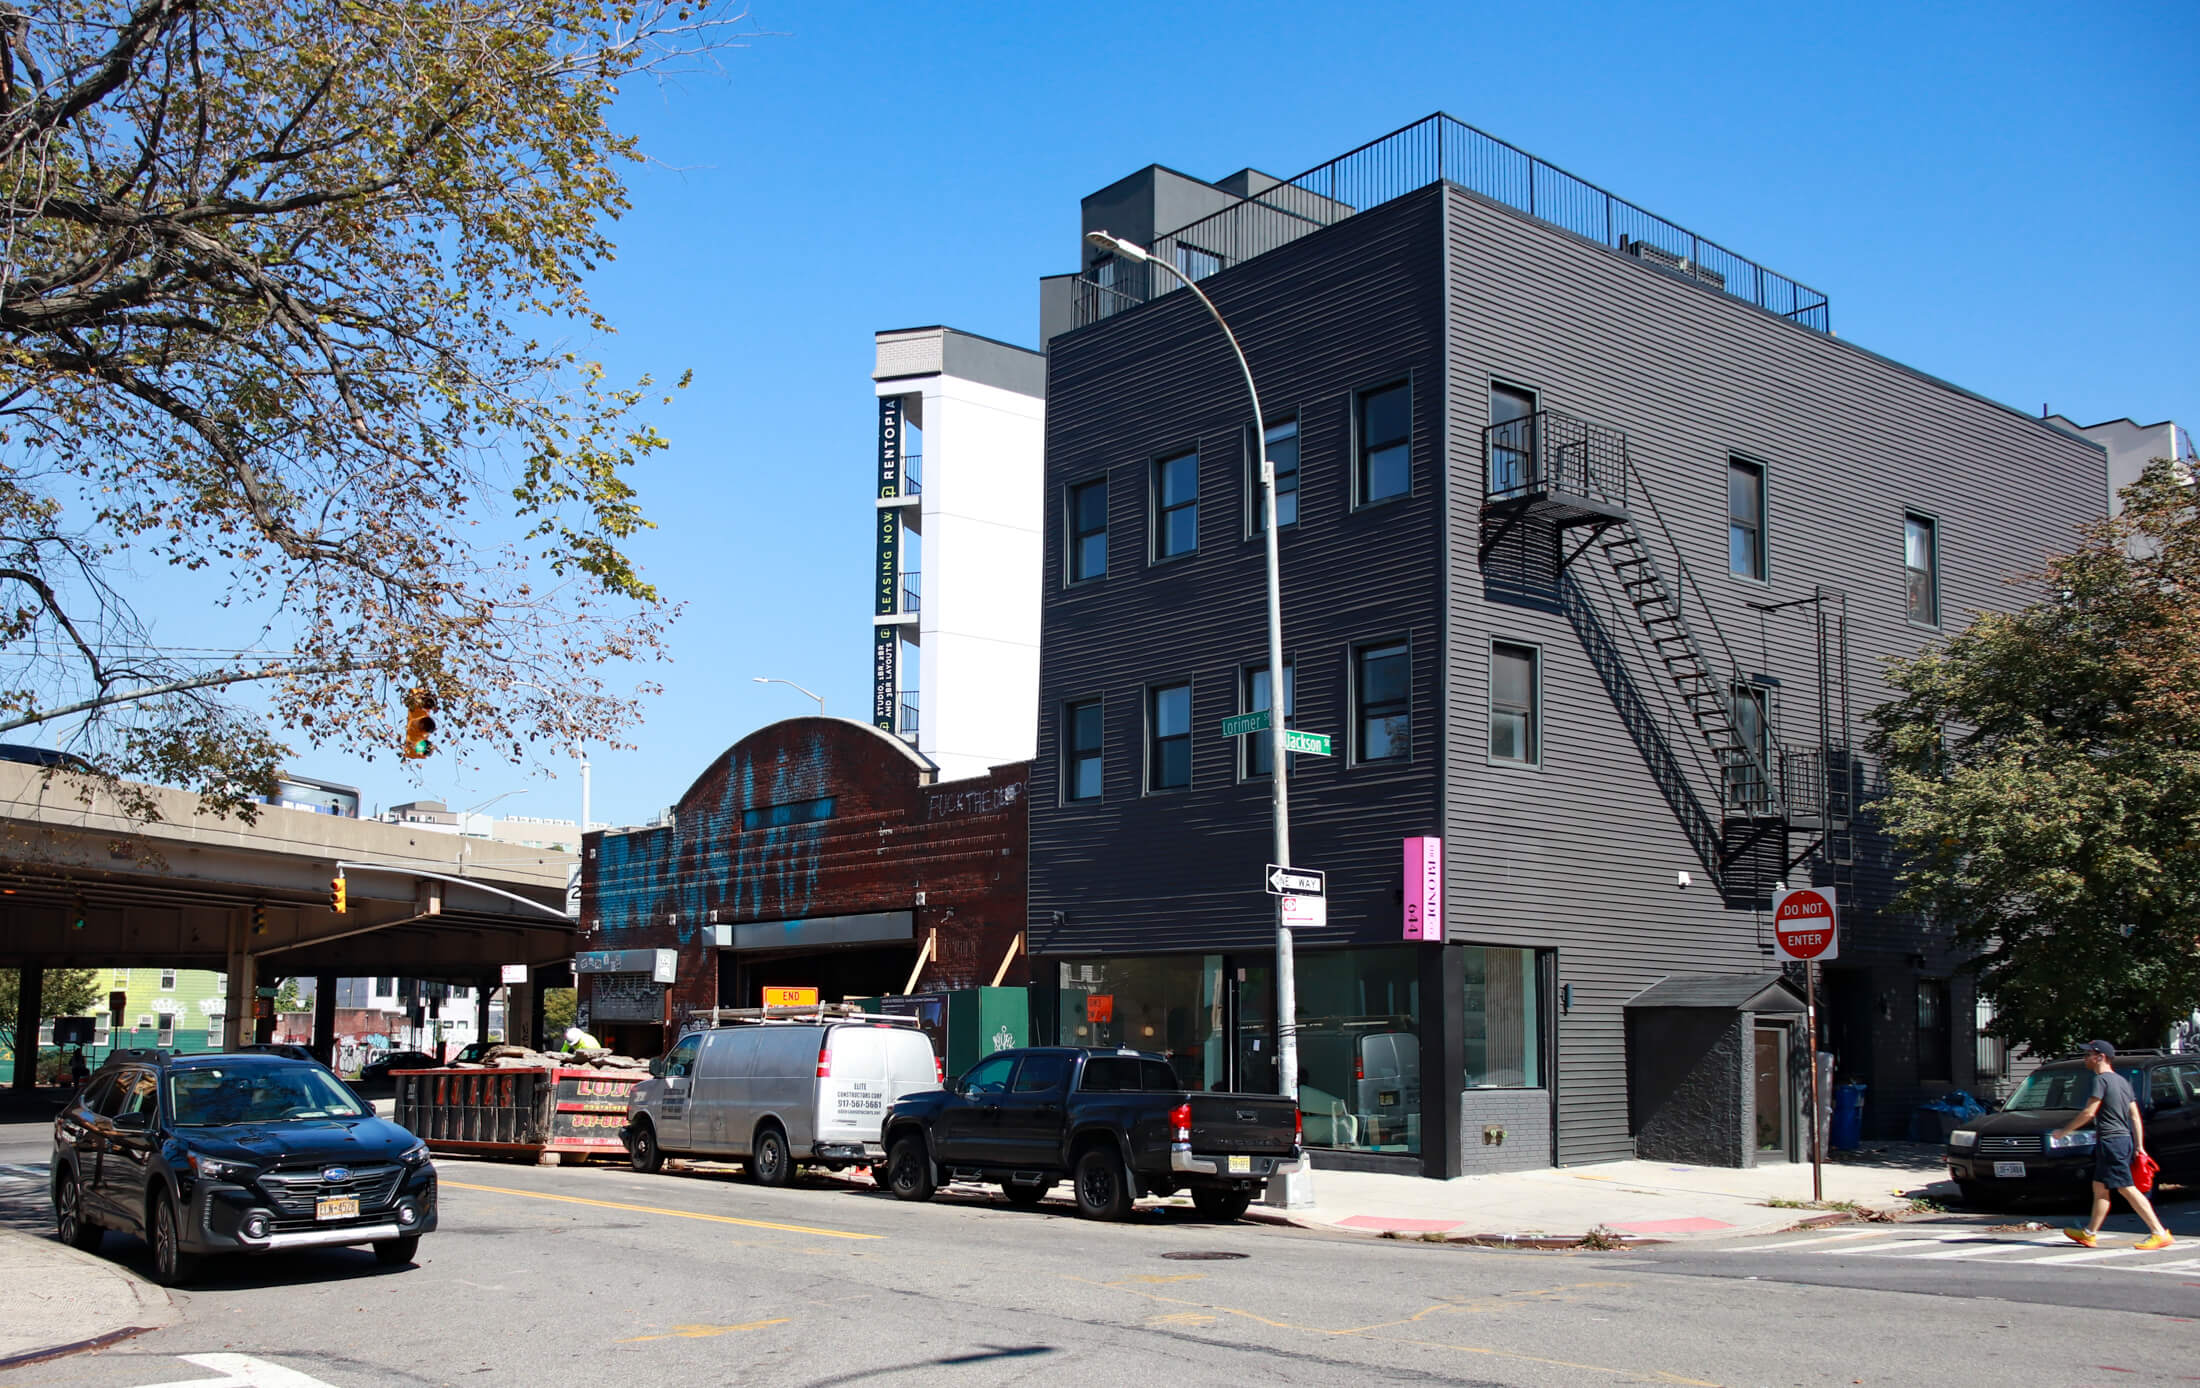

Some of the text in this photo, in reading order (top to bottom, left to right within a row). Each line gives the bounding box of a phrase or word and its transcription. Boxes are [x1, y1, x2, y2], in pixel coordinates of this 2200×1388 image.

[883, 400, 896, 480] RENTOPIA
[882, 512, 893, 613] LEASING NOW
[885, 642, 893, 680] LAYOUTS
[1222, 716, 1260, 737] Lorimer
[1286, 732, 1322, 753] Jackson
[1298, 879, 1316, 889] WAY
[1784, 902, 1823, 916] DO NOT
[1788, 934, 1822, 946] ENTER
[783, 991, 799, 1001] END
